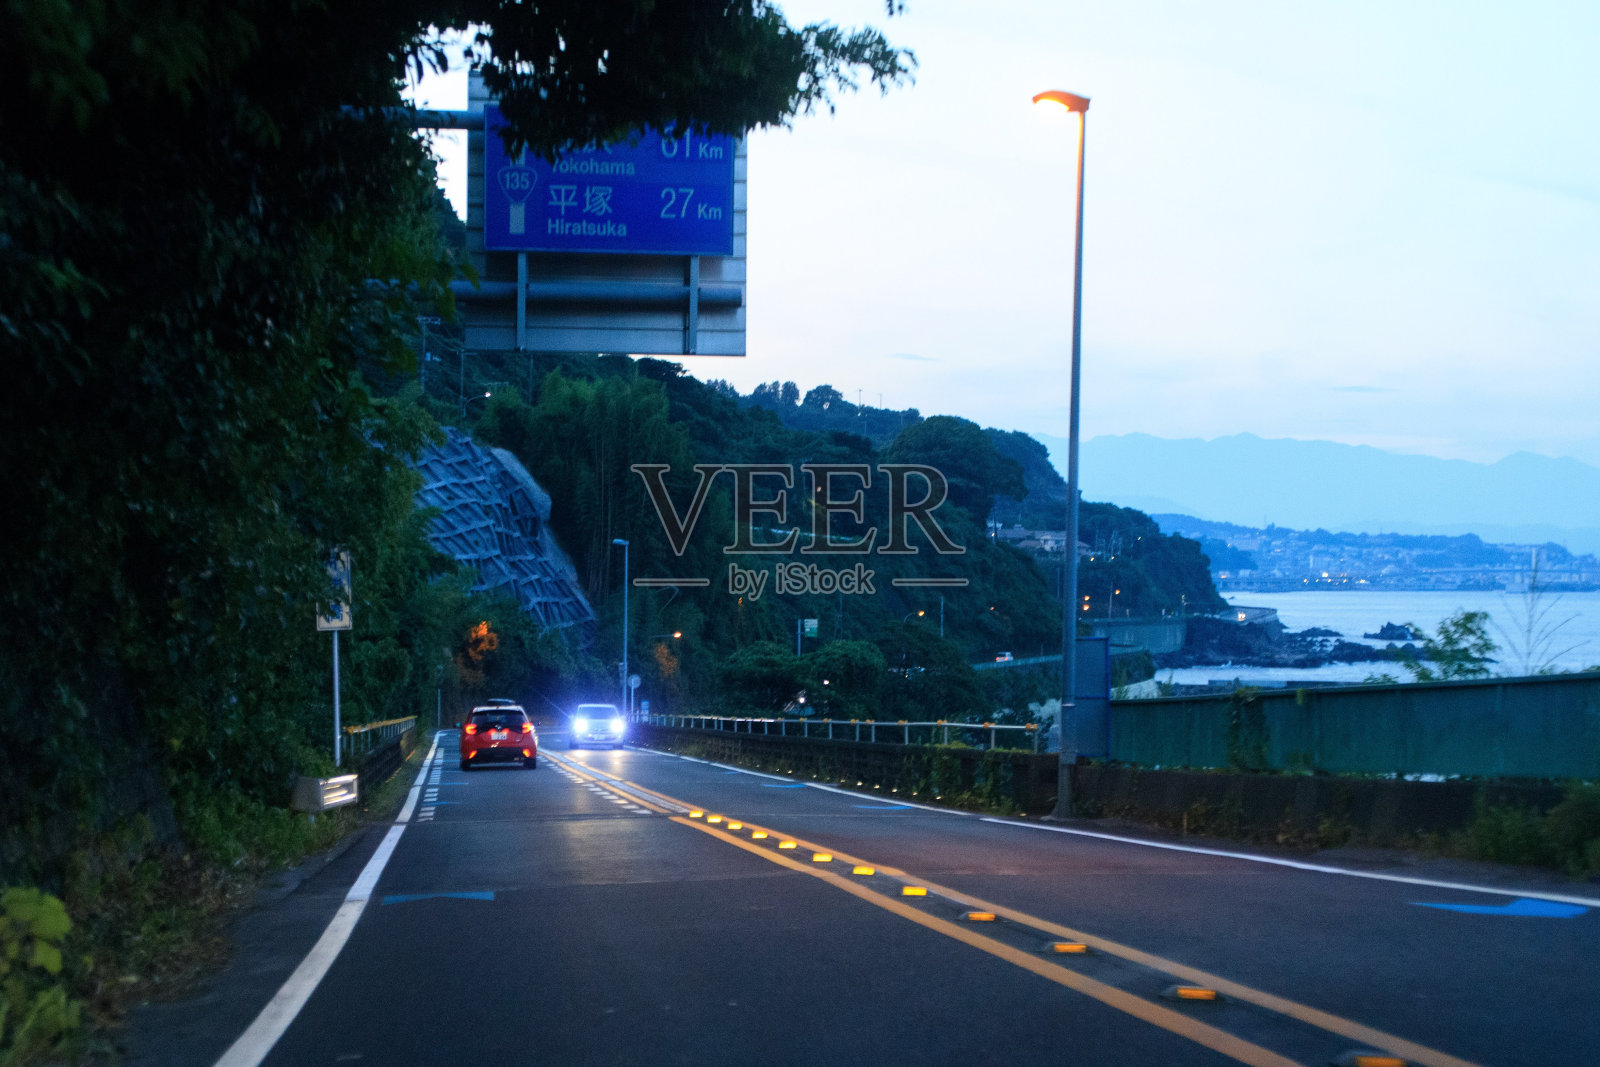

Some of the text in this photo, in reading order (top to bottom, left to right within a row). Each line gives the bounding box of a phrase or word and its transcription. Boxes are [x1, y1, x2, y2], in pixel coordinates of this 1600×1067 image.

[698, 142, 723, 159] Km
[504, 172, 530, 190] 135
[548, 185, 613, 216] 平塚
[660, 187, 722, 221] 27 Km
[547, 218, 627, 237] Hiratsuka
